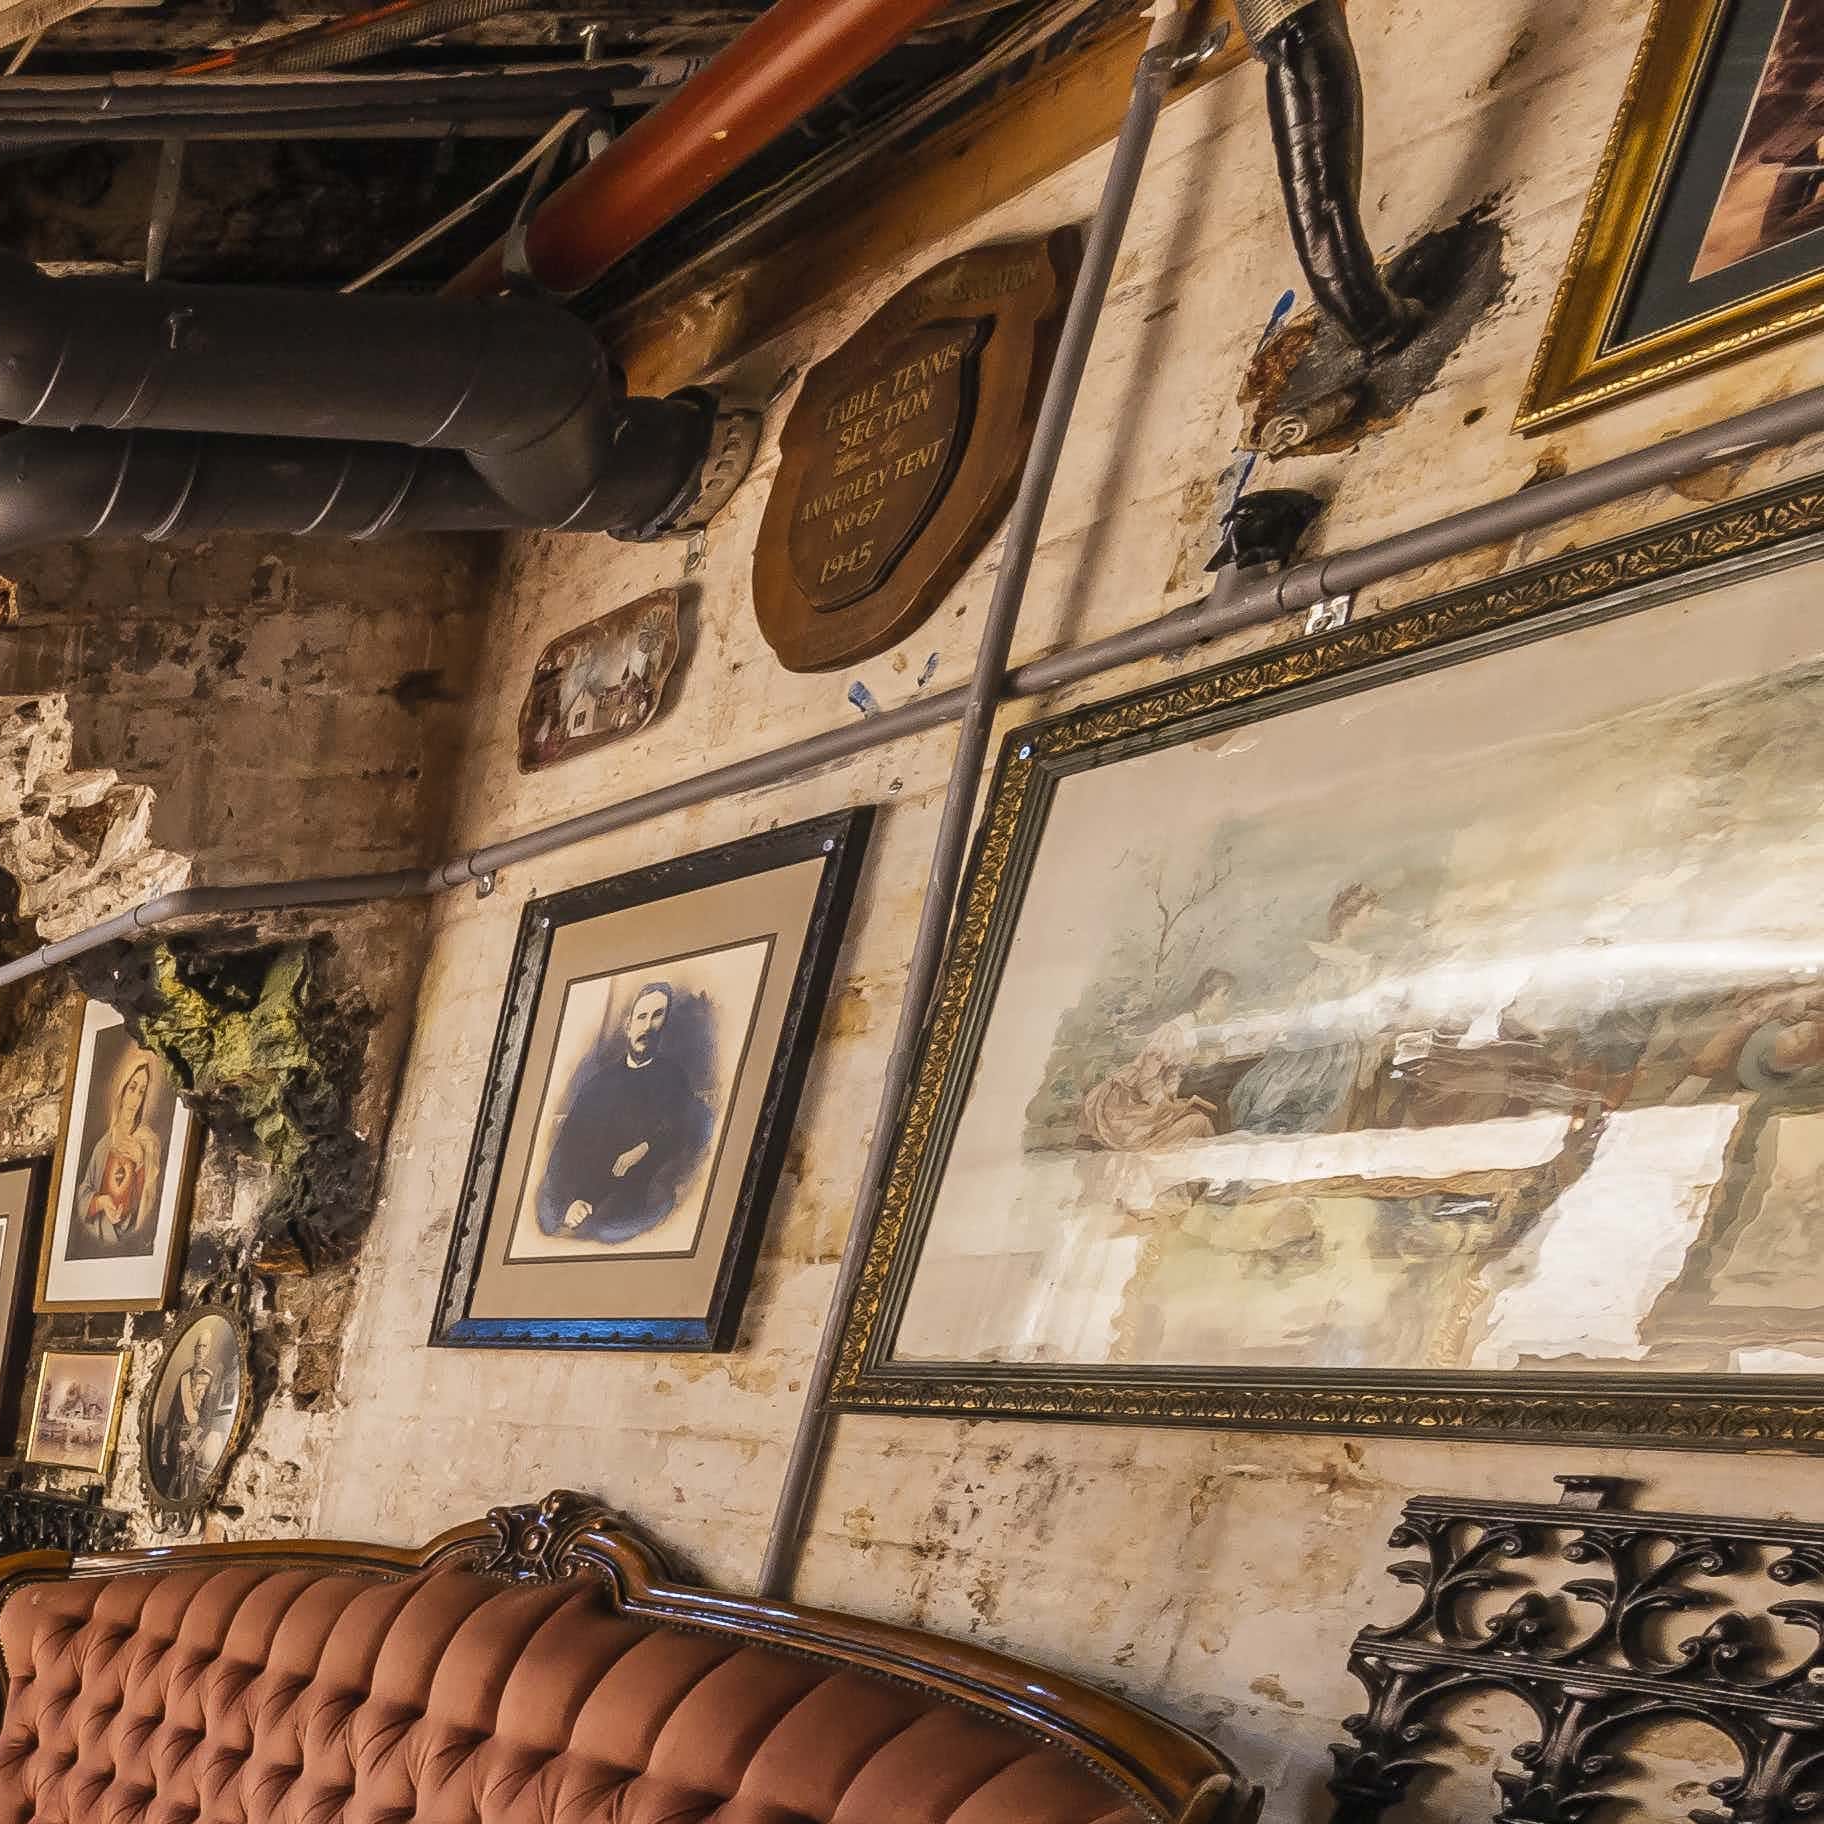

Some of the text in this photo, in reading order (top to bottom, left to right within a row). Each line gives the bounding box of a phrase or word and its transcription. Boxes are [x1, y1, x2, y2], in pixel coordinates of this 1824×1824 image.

[825, 342, 961, 432] TABLE TENNIS
[836, 386, 935, 453] SECTION
[800, 467, 891, 523] ANNERLEY
[894, 438, 945, 481] TENT
[819, 539, 874, 585] 1945
